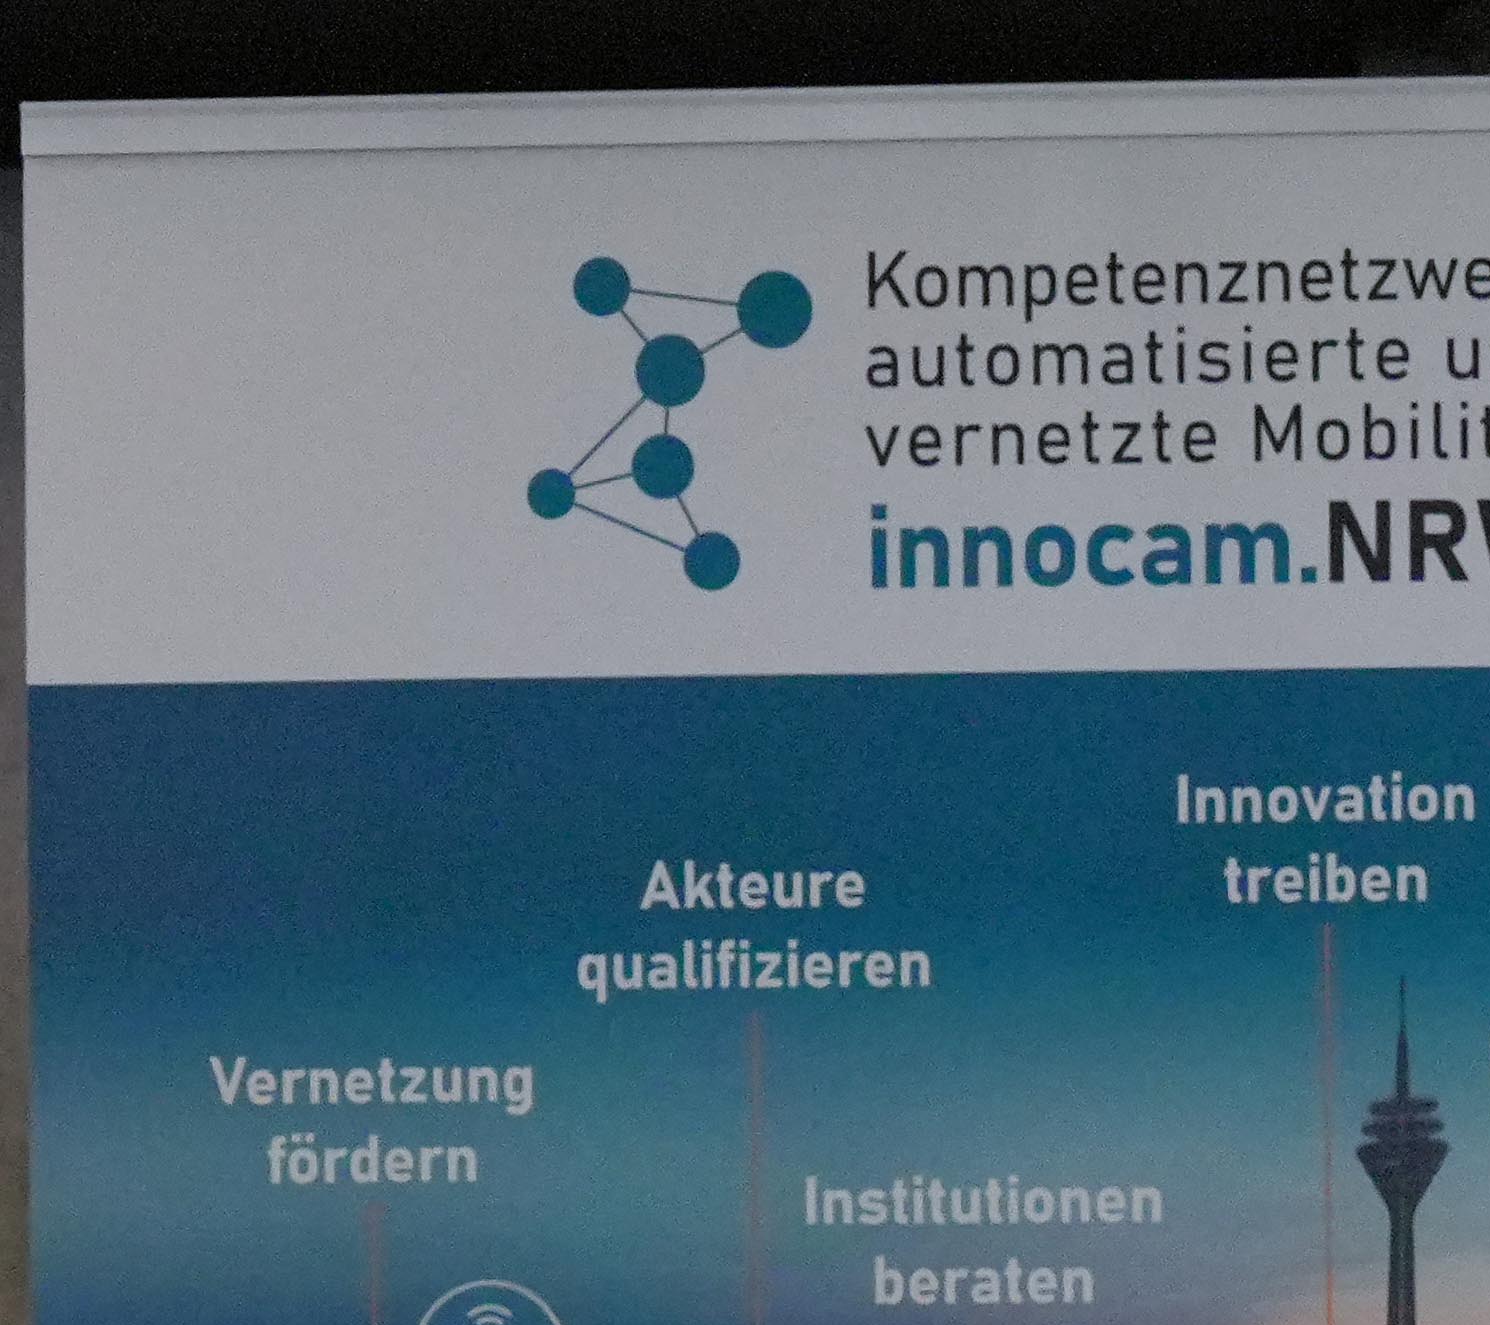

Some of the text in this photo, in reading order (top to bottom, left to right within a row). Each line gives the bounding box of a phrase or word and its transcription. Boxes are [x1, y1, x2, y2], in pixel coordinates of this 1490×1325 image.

[867, 325, 1409, 388] automatisierte
[866, 411, 1216, 467] vernetzte
[1178, 771, 1474, 823] Innovation
[641, 860, 864, 909] Akteure
[1224, 853, 1427, 903] treiben
[578, 940, 930, 1003] qualifizieren
[210, 1057, 533, 1115] Vernetzung
[268, 1133, 477, 1184] fördern
[800, 1175, 1161, 1232] Institutionen
[875, 1256, 1093, 1304] beraten
